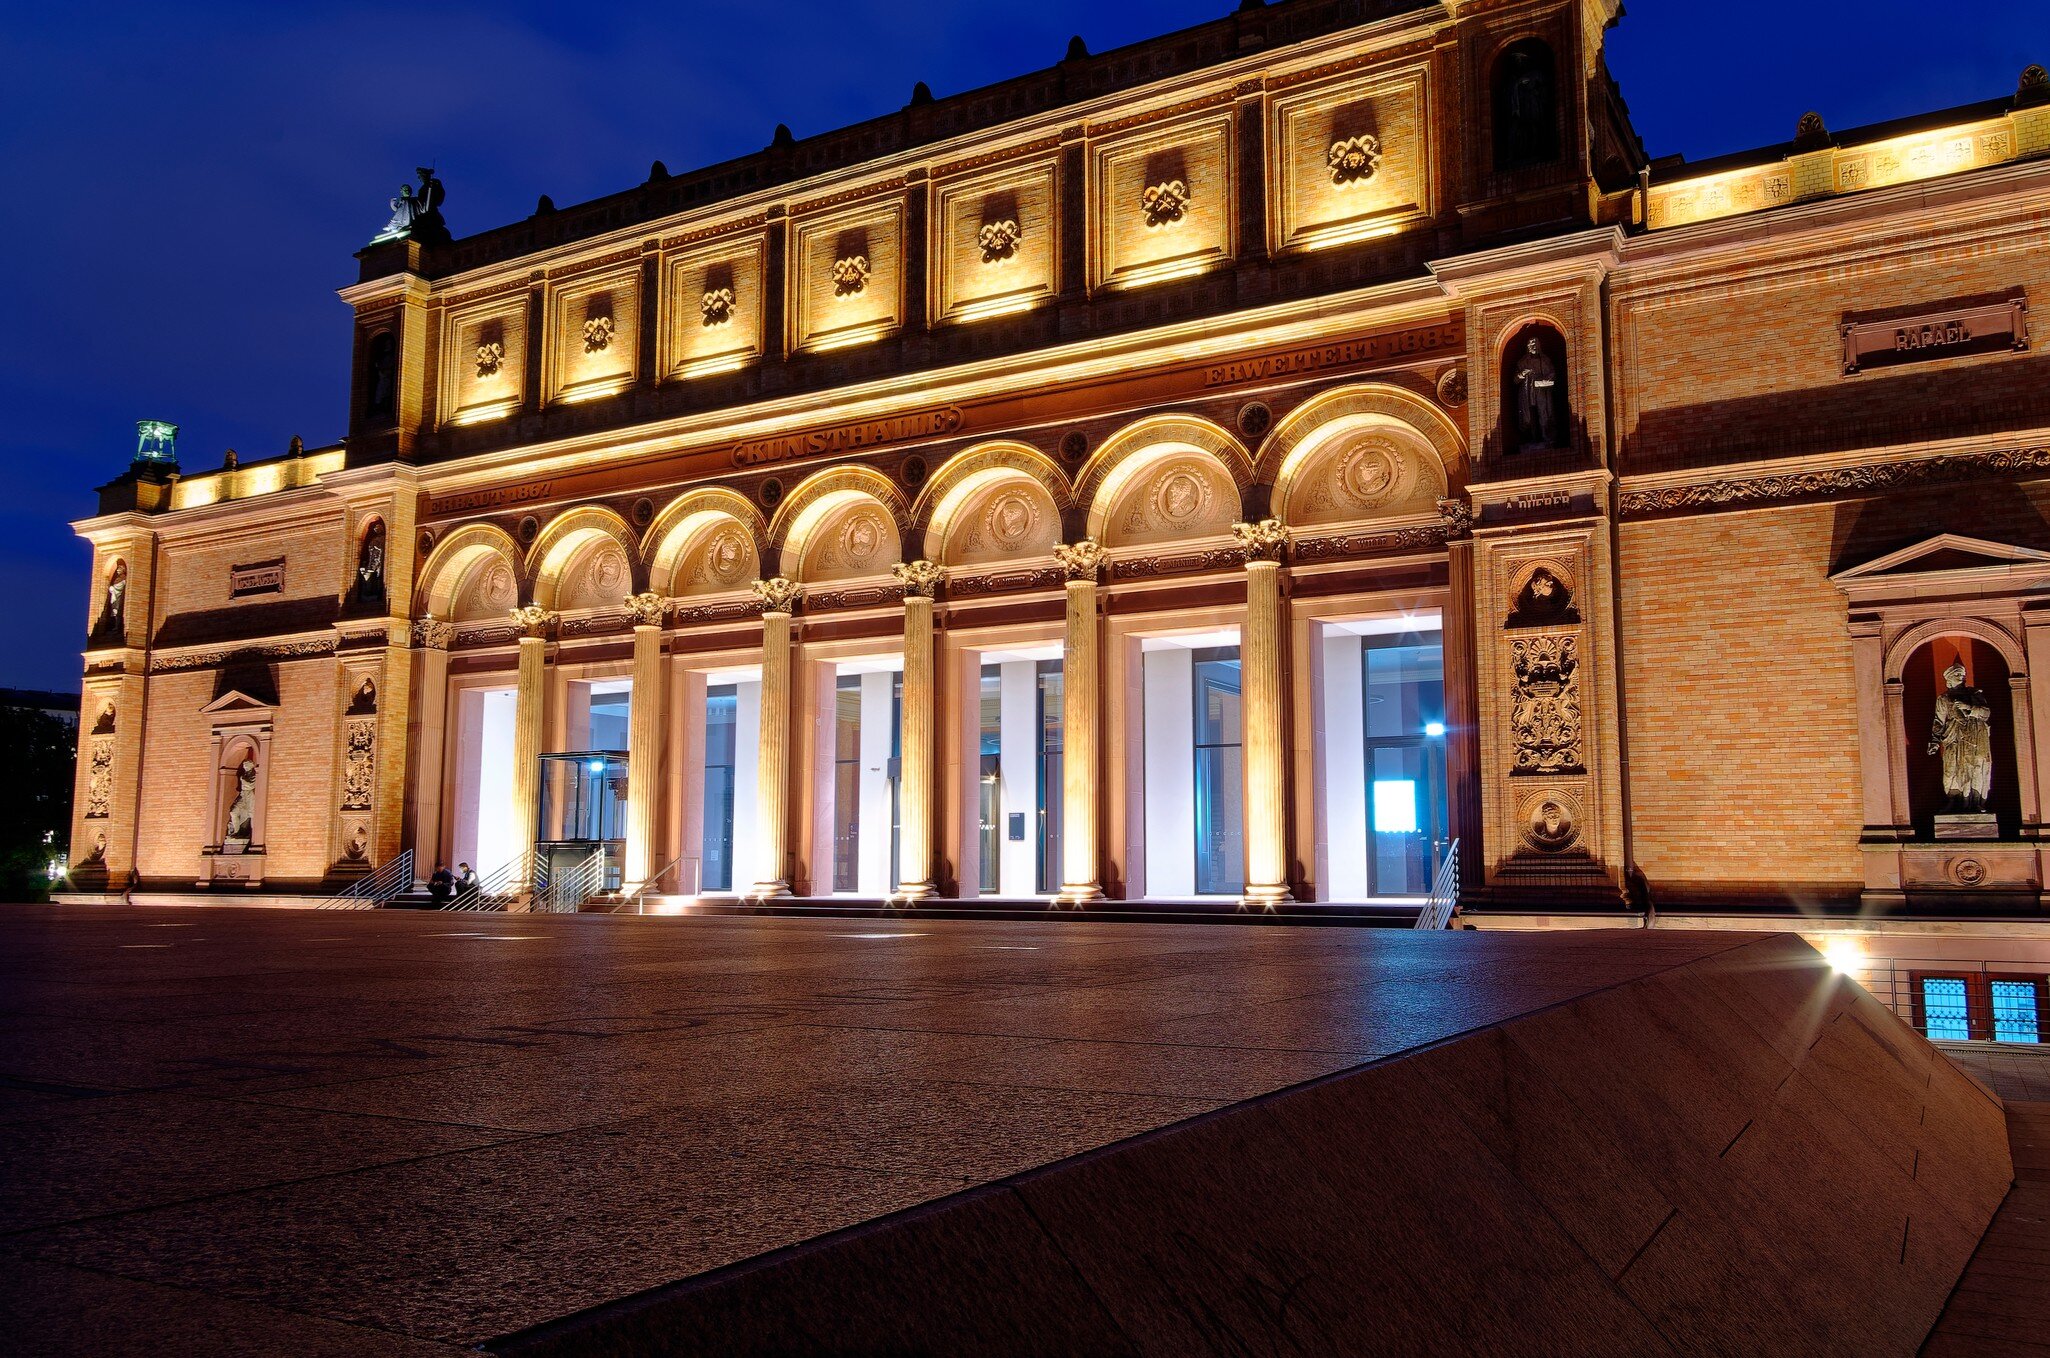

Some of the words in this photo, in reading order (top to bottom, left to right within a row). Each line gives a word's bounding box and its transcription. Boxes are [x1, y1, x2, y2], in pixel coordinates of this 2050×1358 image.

[1204, 341, 1378, 386] ERWEITERT
[1387, 327, 1461, 355] 1885
[1896, 326, 1971, 351] RAFAEL
[746, 410, 948, 464] KUNSTHALLE
[430, 491, 504, 514] ERBAUT
[509, 482, 552, 503] 1867
